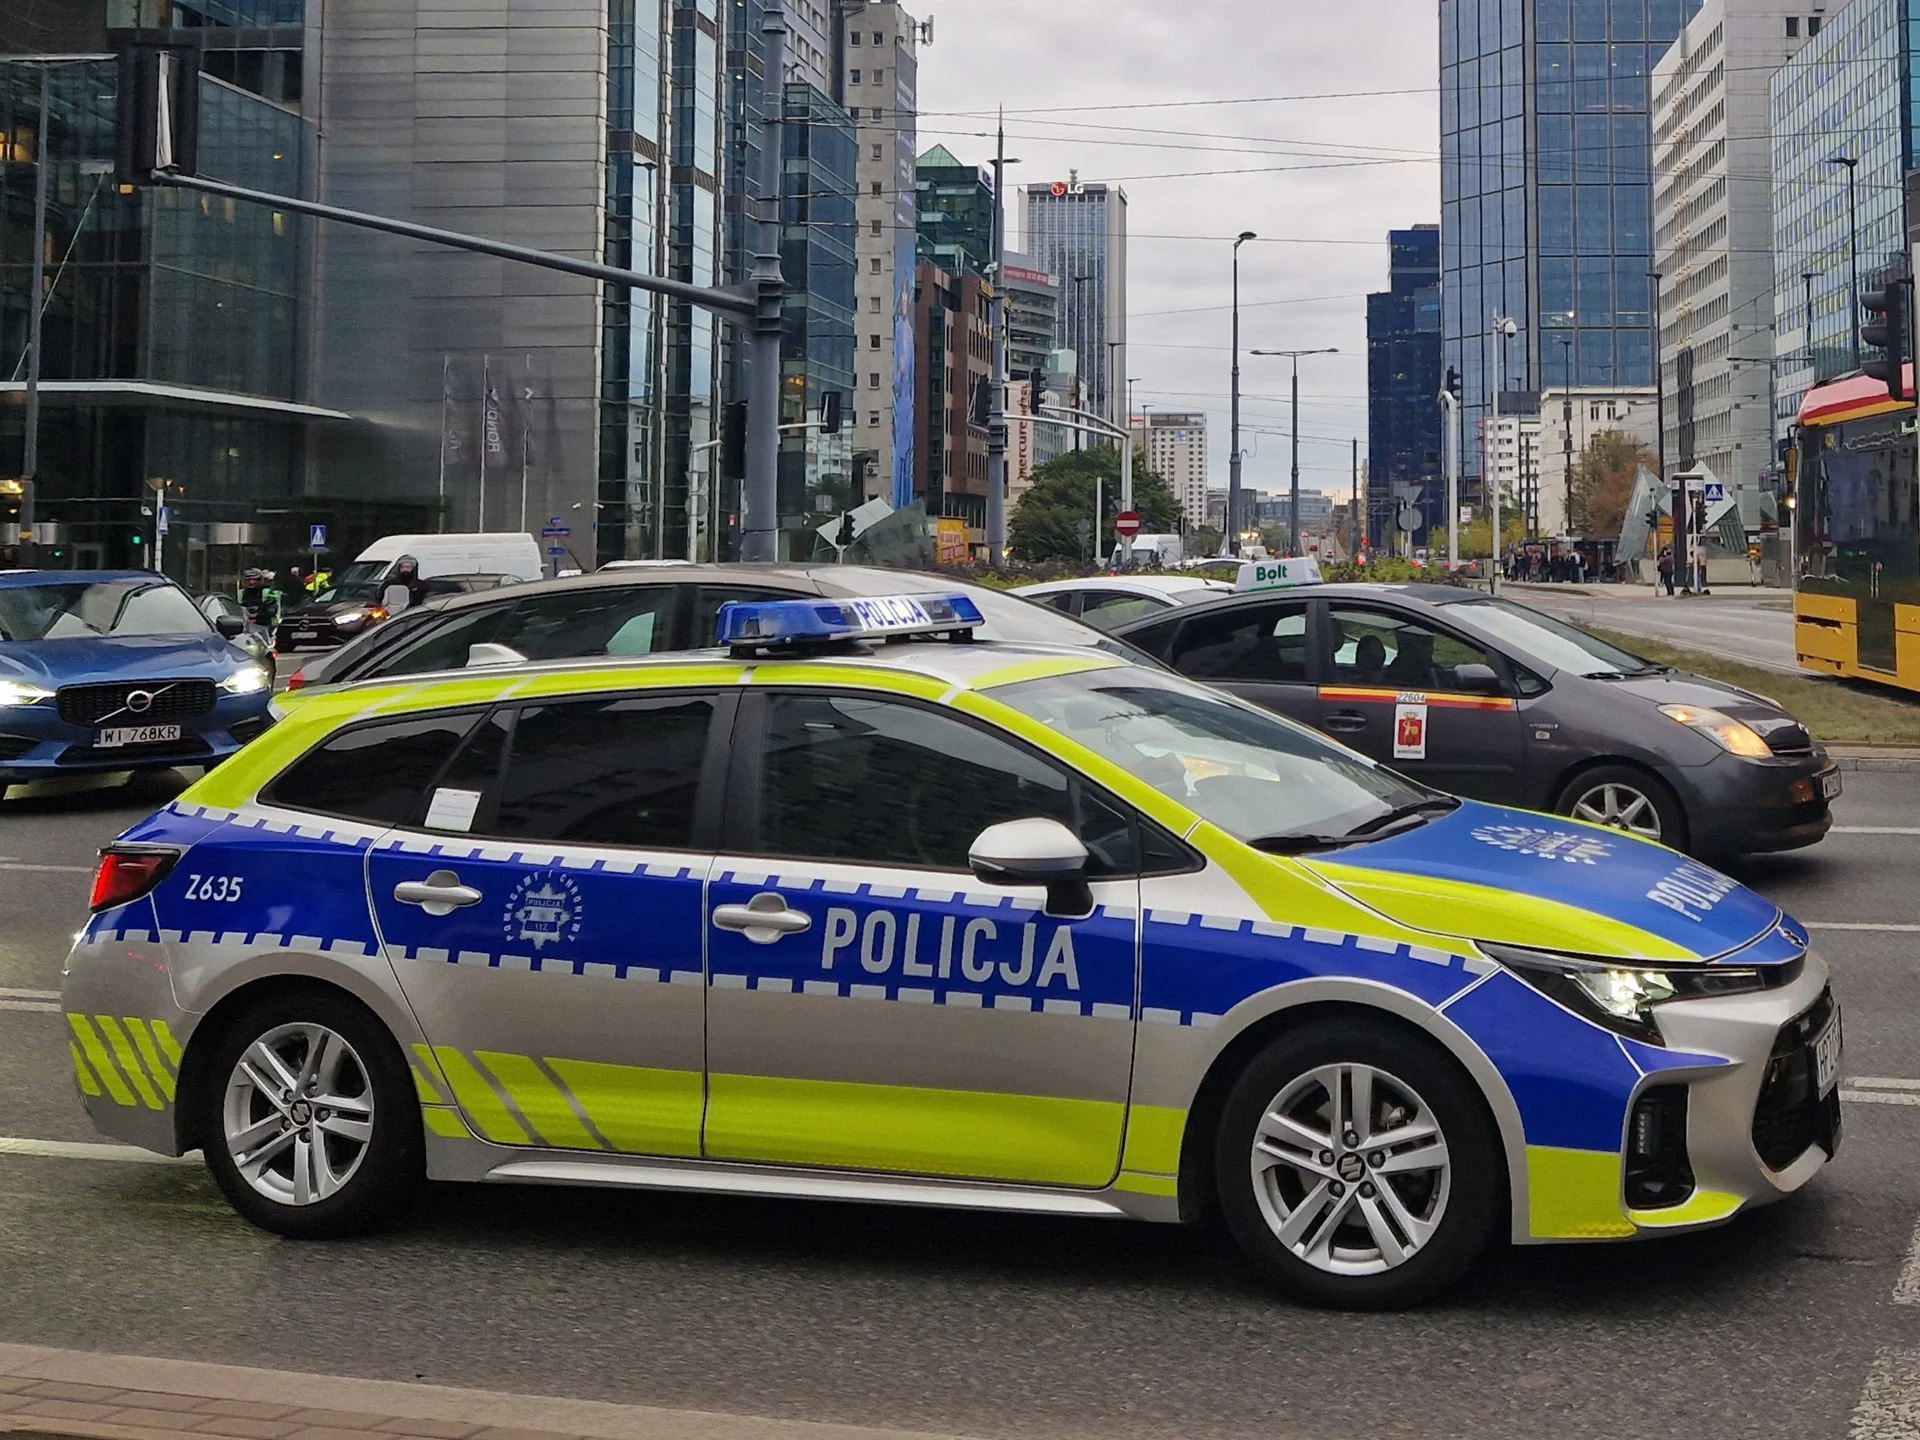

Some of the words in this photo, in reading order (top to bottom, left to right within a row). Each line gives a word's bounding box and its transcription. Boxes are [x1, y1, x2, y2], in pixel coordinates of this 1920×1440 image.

[1067, 183, 1084, 195] LG
[1256, 565, 1288, 582] Bolt
[853, 598, 928, 629] POLICJA
[1397, 692, 1425, 703] 22604
[104, 729, 122, 743] WI
[130, 725, 178, 741] 768KR
[184, 873, 244, 902] Z635
[528, 899, 562, 908] POLICJA
[821, 907, 1081, 991] POLICJA
